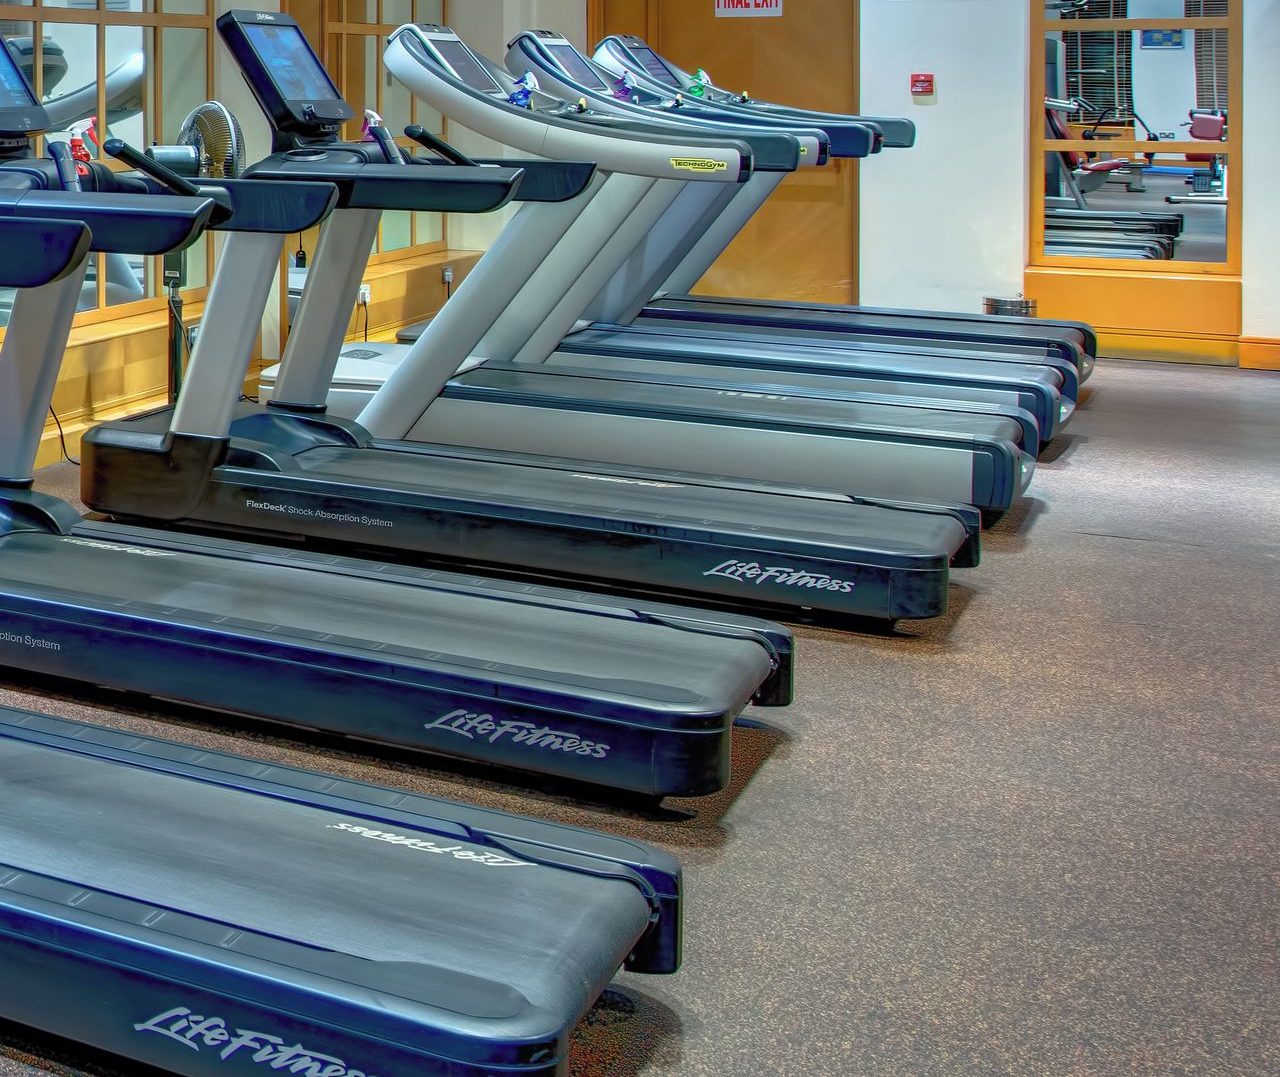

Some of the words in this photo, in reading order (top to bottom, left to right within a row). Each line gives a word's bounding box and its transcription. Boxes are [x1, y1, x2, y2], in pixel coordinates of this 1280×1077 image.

[288, 506, 314, 517] Shock
[314, 510, 360, 523] Absorption
[361, 515, 393, 528] System
[24, 635, 61, 651] System
